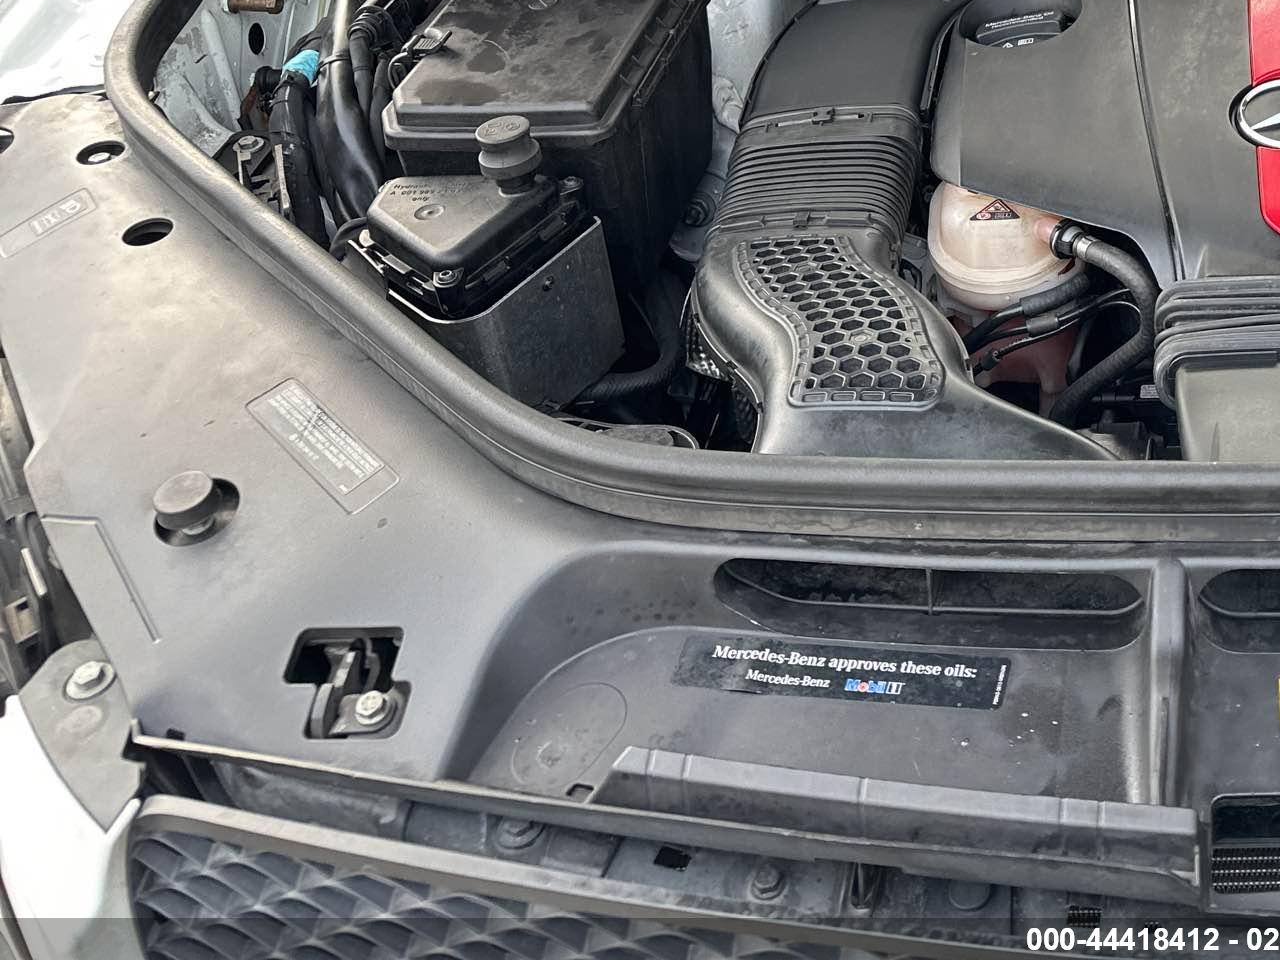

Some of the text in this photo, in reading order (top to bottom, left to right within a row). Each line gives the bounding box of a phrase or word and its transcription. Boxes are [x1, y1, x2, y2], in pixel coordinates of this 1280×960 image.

[712, 645, 977, 678] Mercedes-Benz approves these oils:
[745, 669, 831, 688] Mercedes-Benz
[844, 678, 887, 694] Mobil
